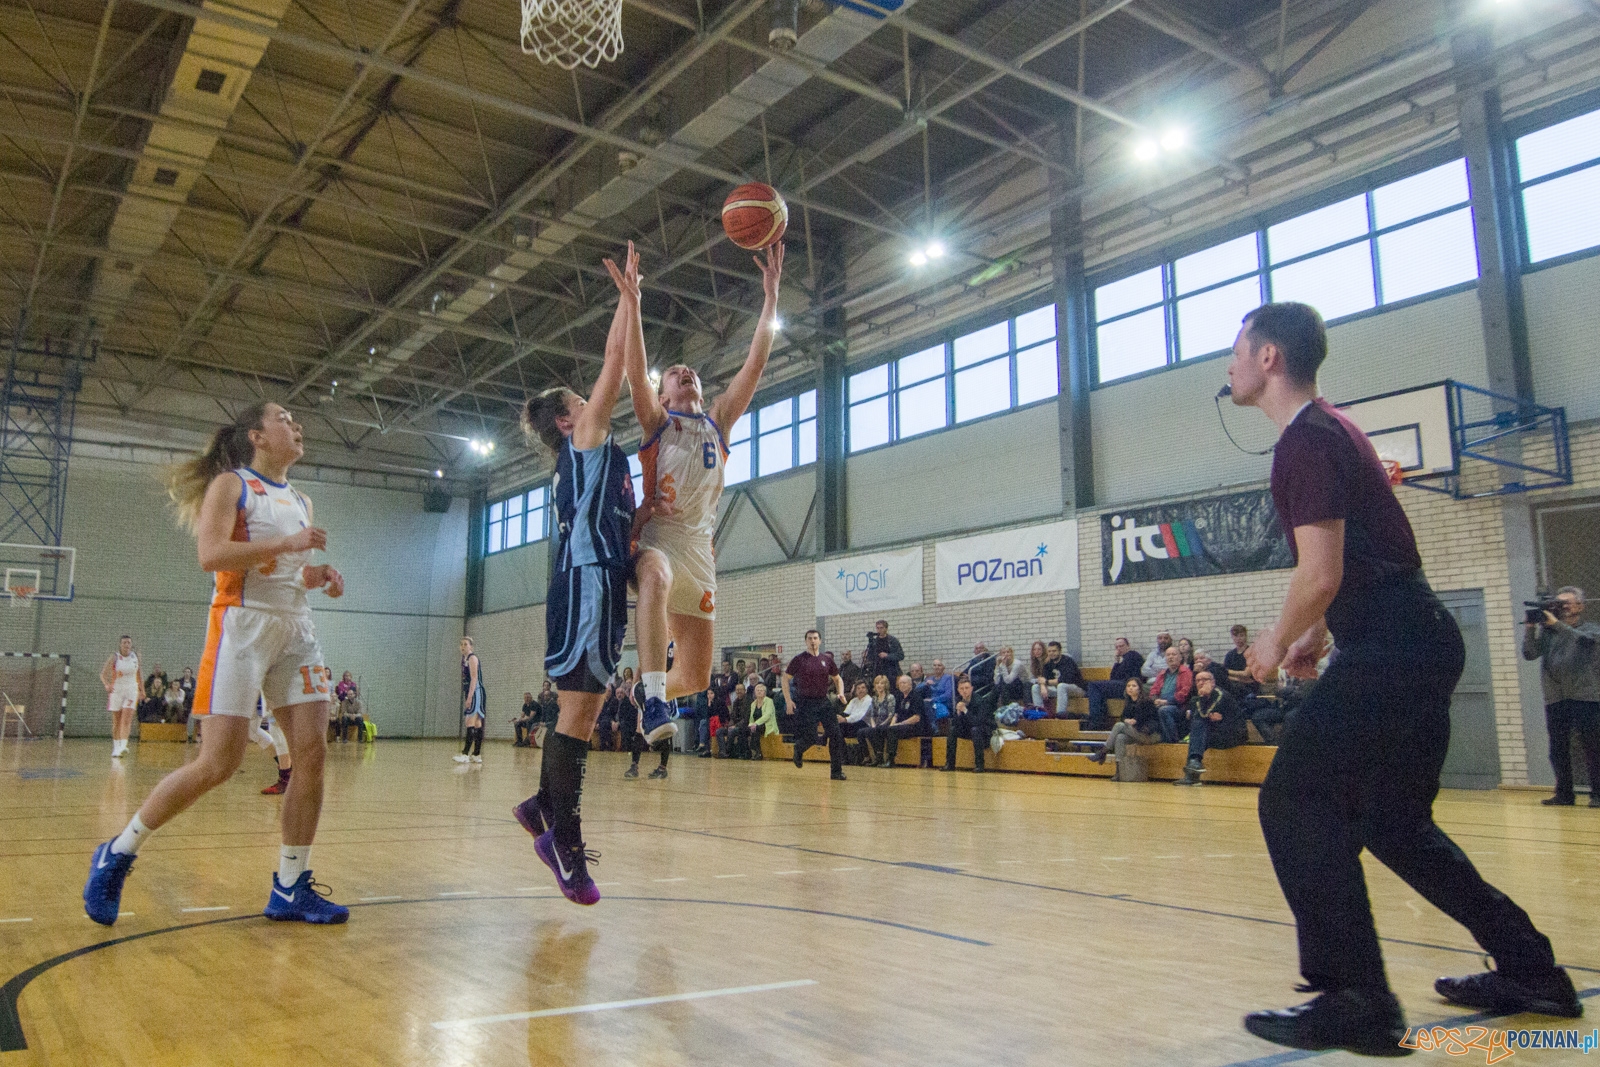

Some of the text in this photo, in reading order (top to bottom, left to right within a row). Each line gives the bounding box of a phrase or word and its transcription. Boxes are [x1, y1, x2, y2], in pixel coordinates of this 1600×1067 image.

[703, 442, 717, 469] 6
[1109, 515, 1168, 583] jtc
[845, 564, 889, 599] posir
[300, 665, 328, 694] 13
